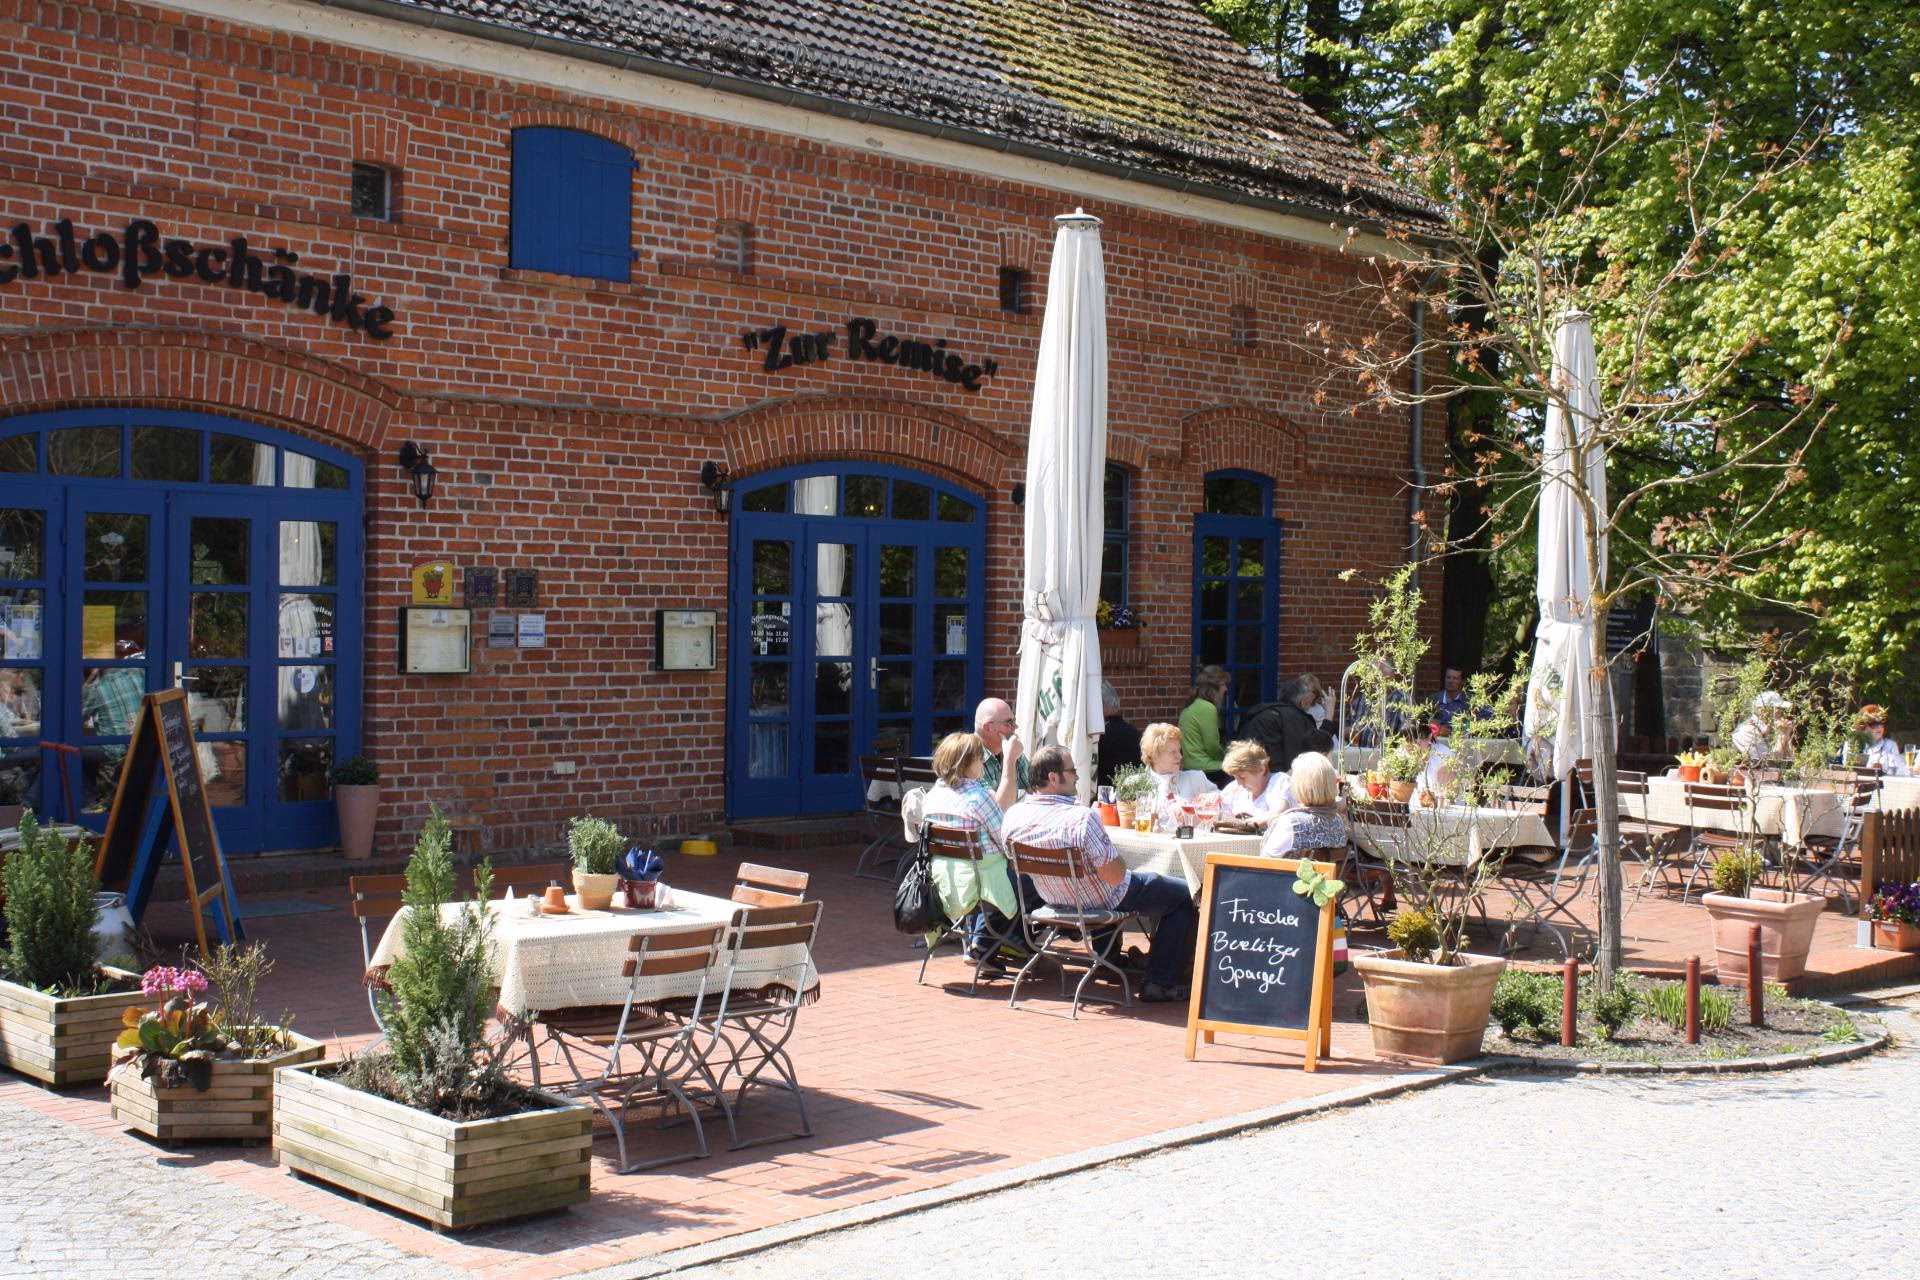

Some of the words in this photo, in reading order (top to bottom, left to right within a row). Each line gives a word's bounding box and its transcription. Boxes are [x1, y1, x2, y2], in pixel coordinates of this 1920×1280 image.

[846, 318, 998, 391] Remise"
[1220, 898, 1299, 927] Frischer
[1218, 956, 1286, 993] Spargel
